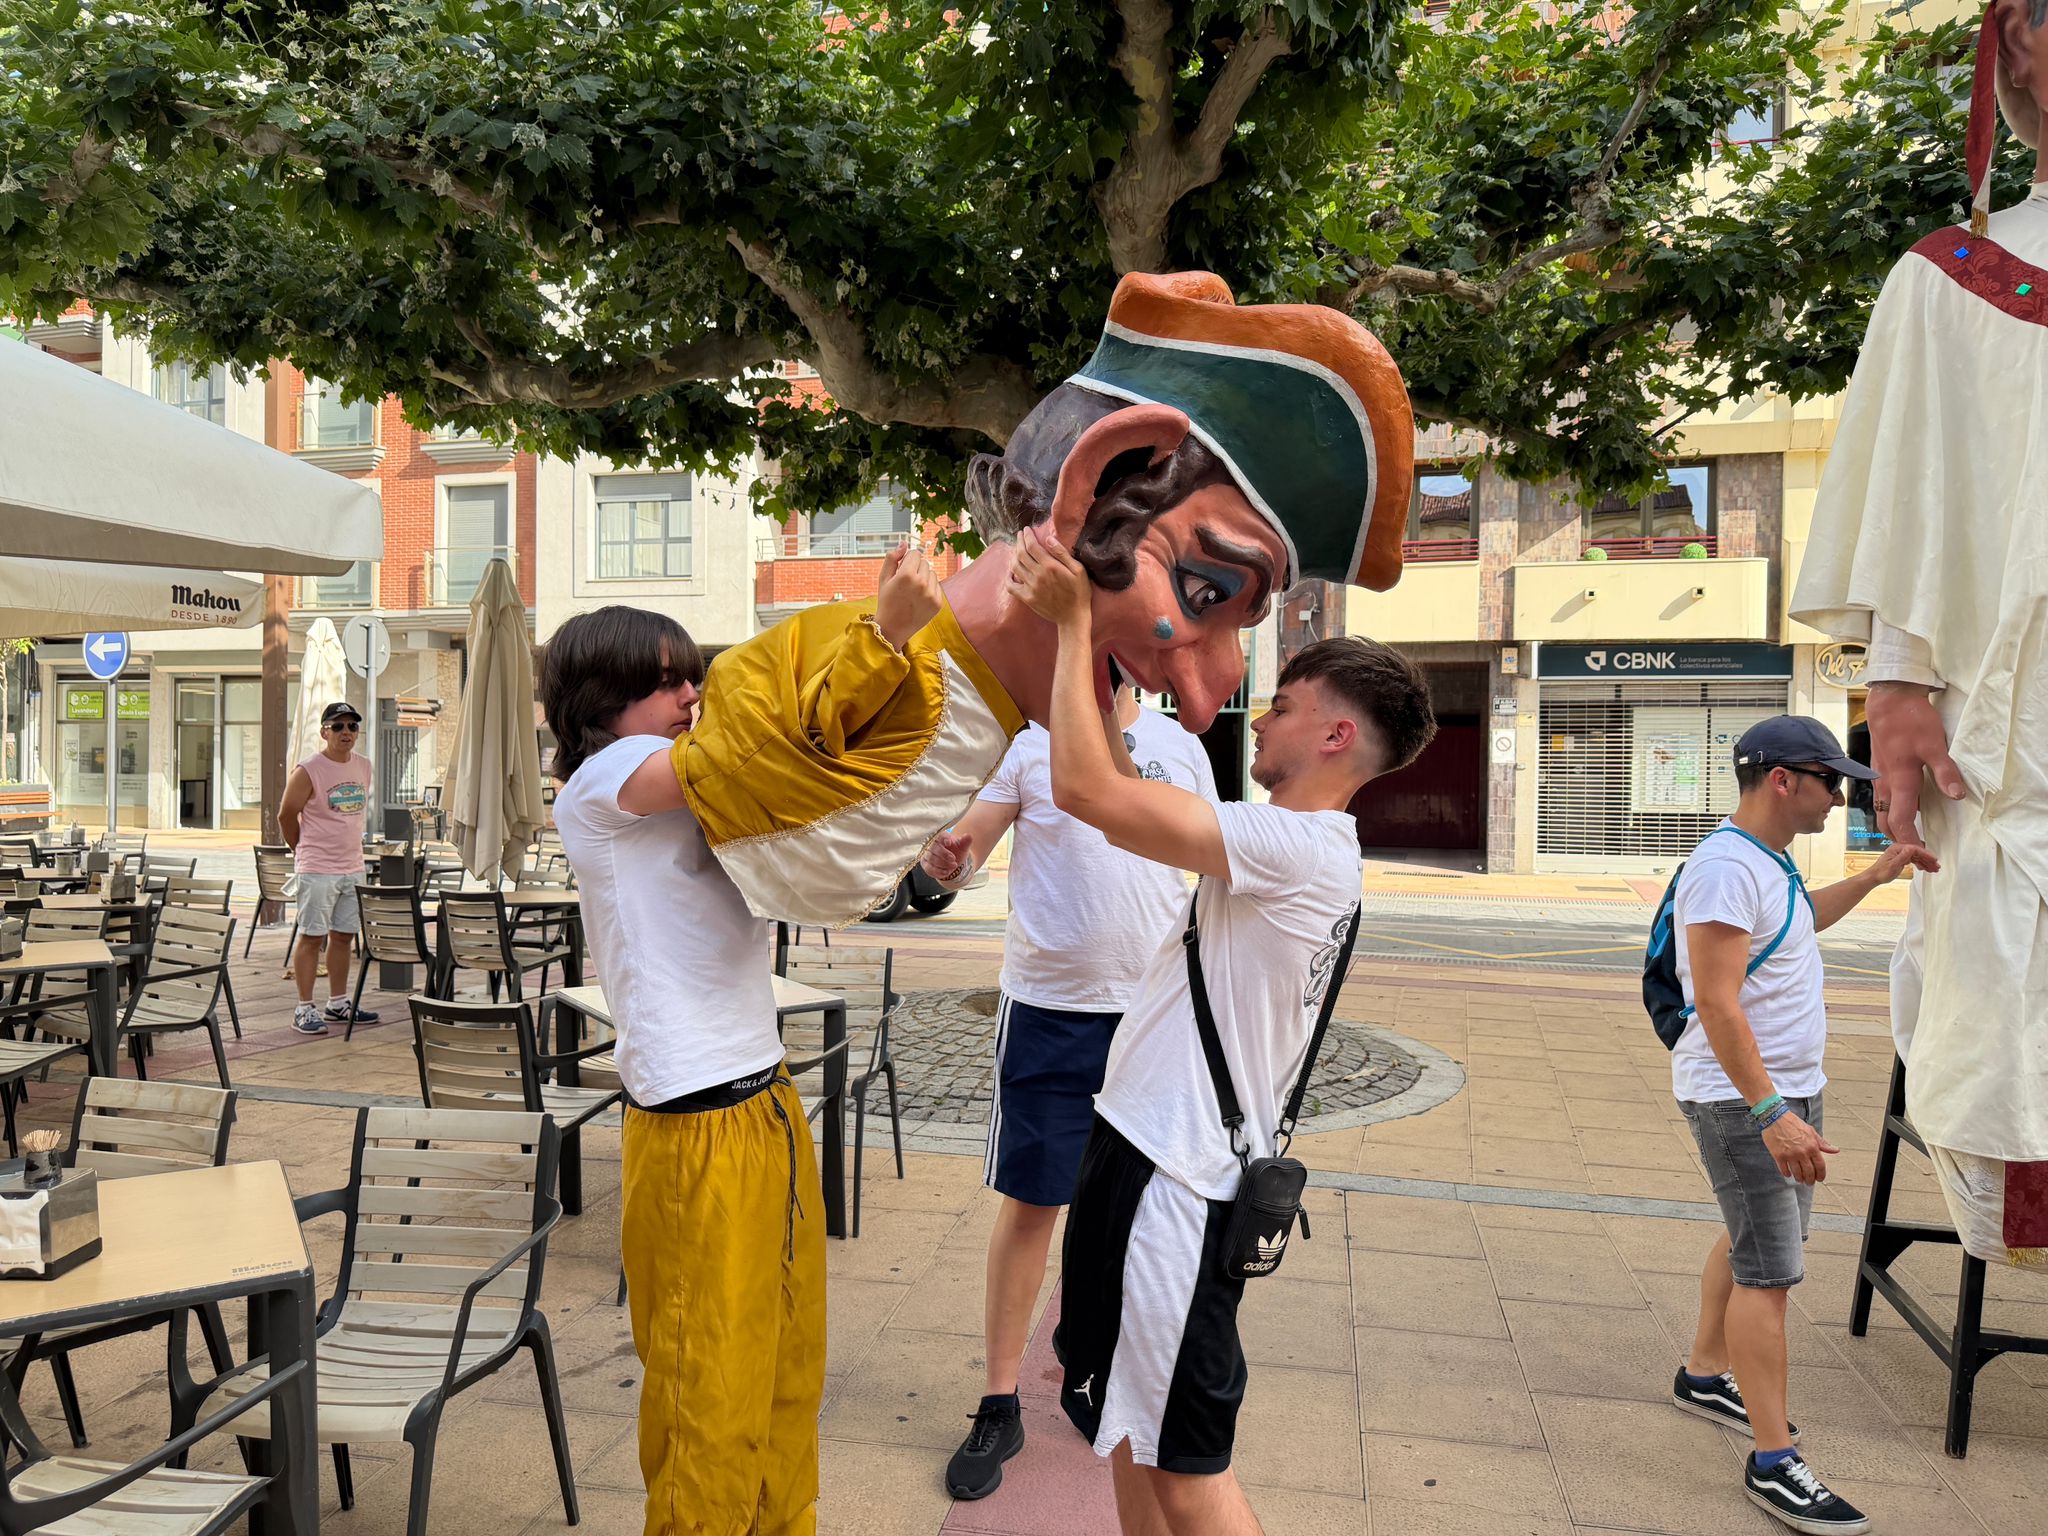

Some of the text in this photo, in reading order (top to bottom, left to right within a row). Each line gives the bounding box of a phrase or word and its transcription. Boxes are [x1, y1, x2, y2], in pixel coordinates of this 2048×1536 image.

[171, 584, 241, 611] Mahou
[171, 610, 238, 625] DESDE 1890
[1613, 652, 1676, 669] CBNK
[1243, 1260, 1275, 1272] adidas
